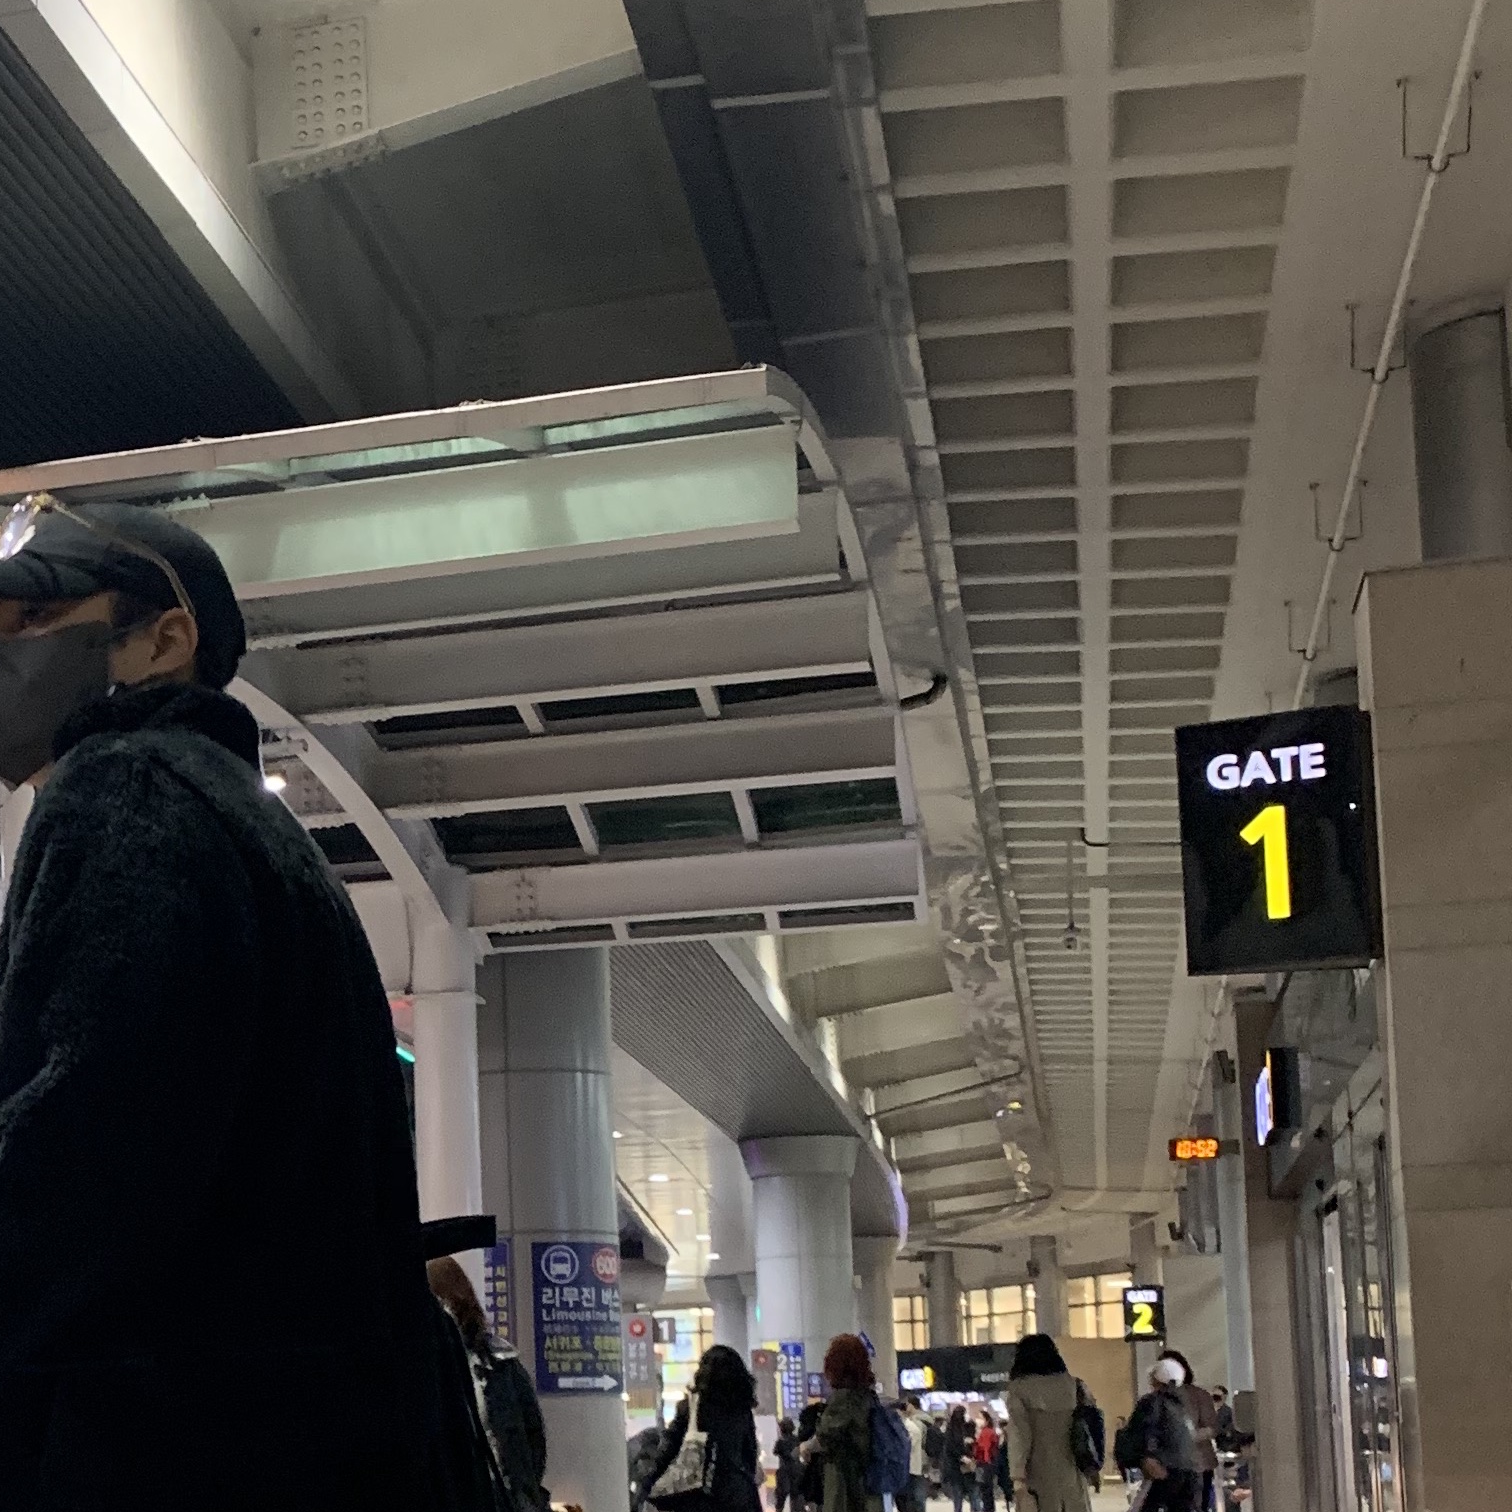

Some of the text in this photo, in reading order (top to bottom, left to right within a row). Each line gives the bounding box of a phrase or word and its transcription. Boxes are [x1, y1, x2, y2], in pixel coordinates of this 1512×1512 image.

[1206, 743, 1327, 790] GATE
[1239, 804, 1291, 920] 1
[542, 1286, 596, 1308] 리무진
[1126, 1290, 1158, 1303] GATE
[542, 1308, 607, 1322] Limousine
[1133, 1303, 1154, 1334] 2
[658, 1321, 669, 1340] 1
[777, 1354, 788, 1370] 2
